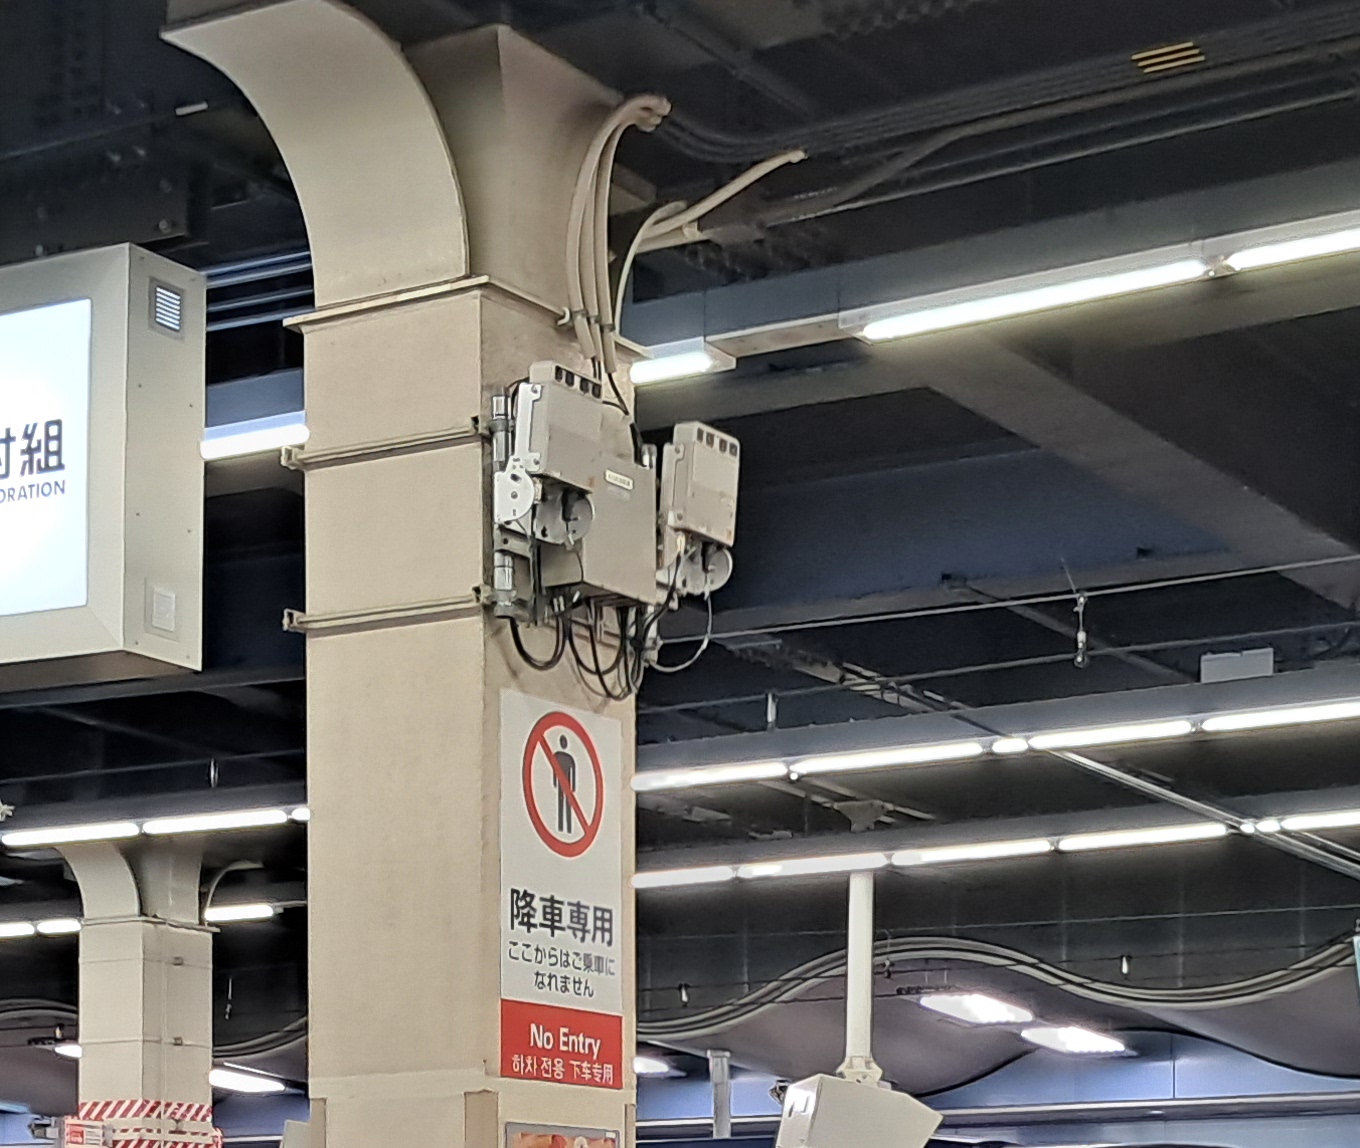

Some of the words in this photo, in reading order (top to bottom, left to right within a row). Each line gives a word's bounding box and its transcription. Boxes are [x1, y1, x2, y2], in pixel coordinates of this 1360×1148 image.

[510, 887, 614, 947] 降車専用
[509, 941, 616, 976] ここからはご乗車に
[534, 971, 595, 998] なれません
[530, 1023, 554, 1050] No
[559, 1027, 601, 1060] Entry
[512, 1054, 538, 1077] 하차
[540, 1056, 566, 1080] 전용
[569, 1059, 614, 1085] 下车专用
